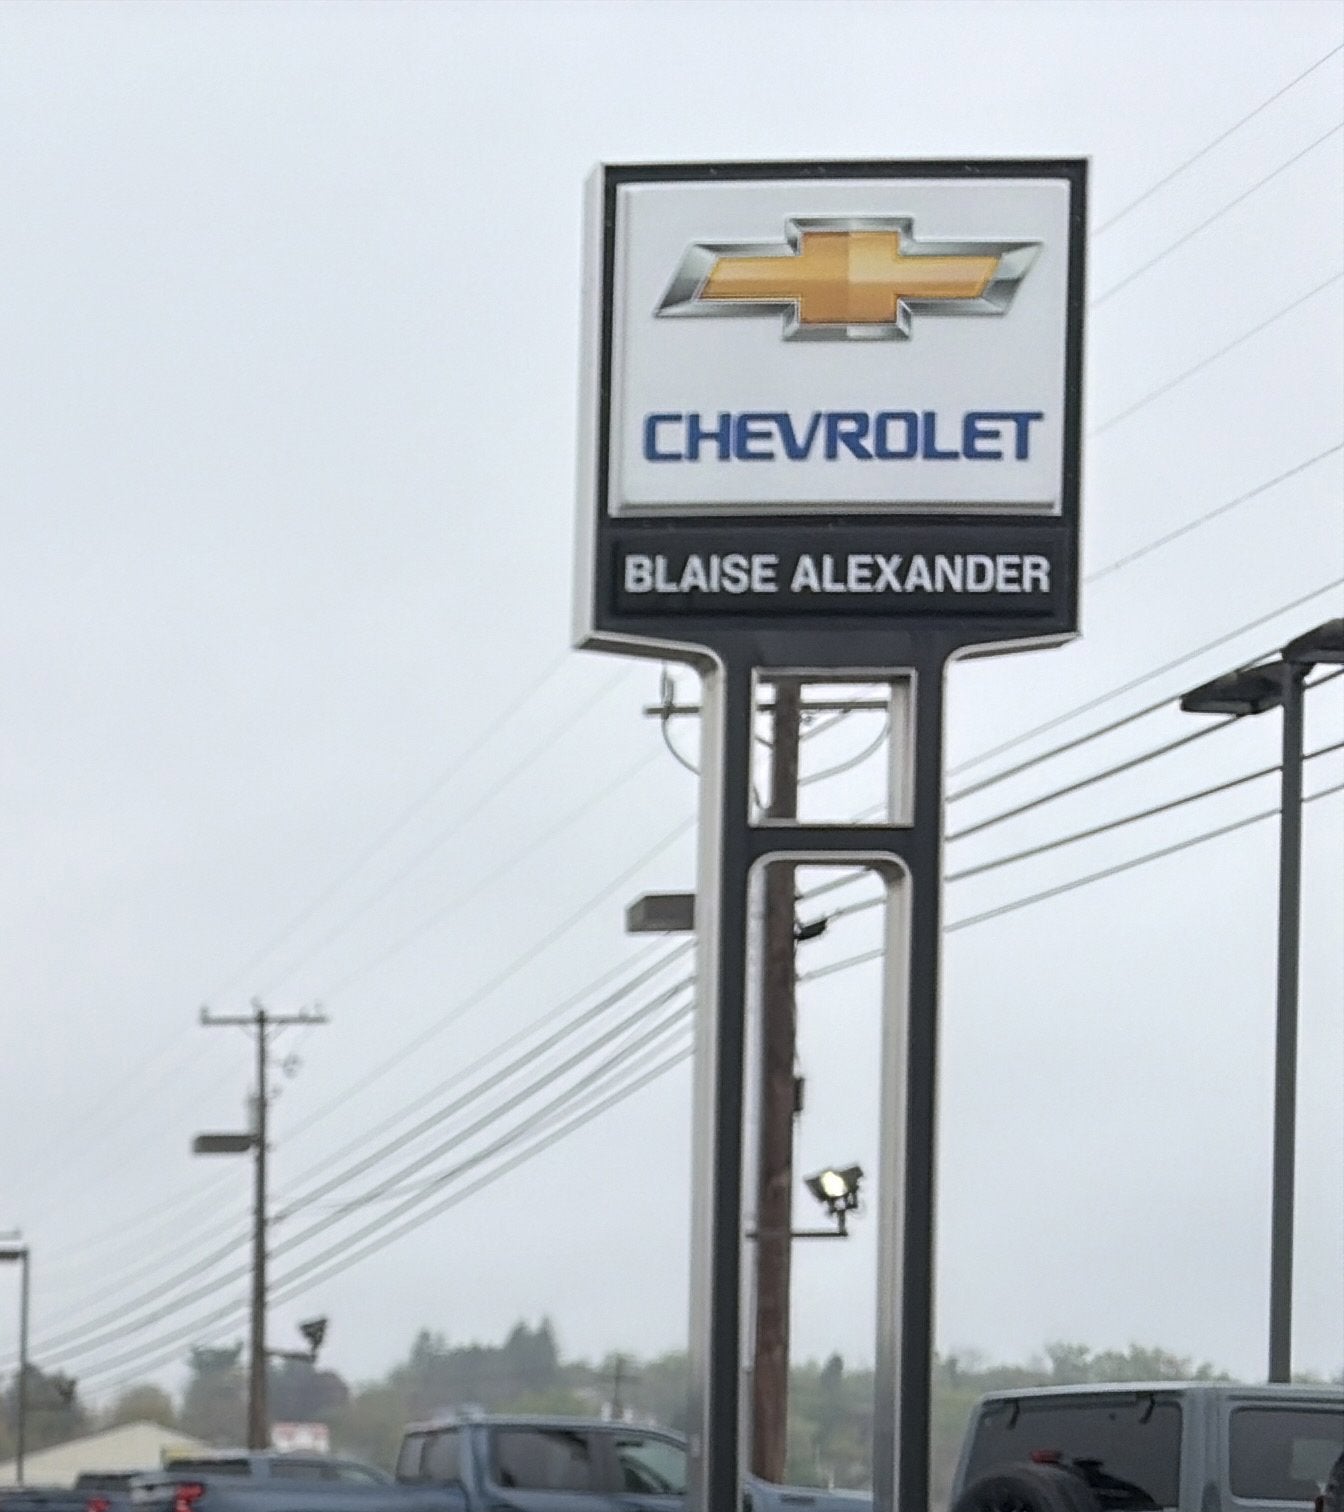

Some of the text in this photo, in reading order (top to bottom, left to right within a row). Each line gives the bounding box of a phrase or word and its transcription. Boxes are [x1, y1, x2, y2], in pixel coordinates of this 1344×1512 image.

[643, 411, 1045, 462] CHEVROLET
[623, 553, 1052, 594] BLAISE ALEXANDER
